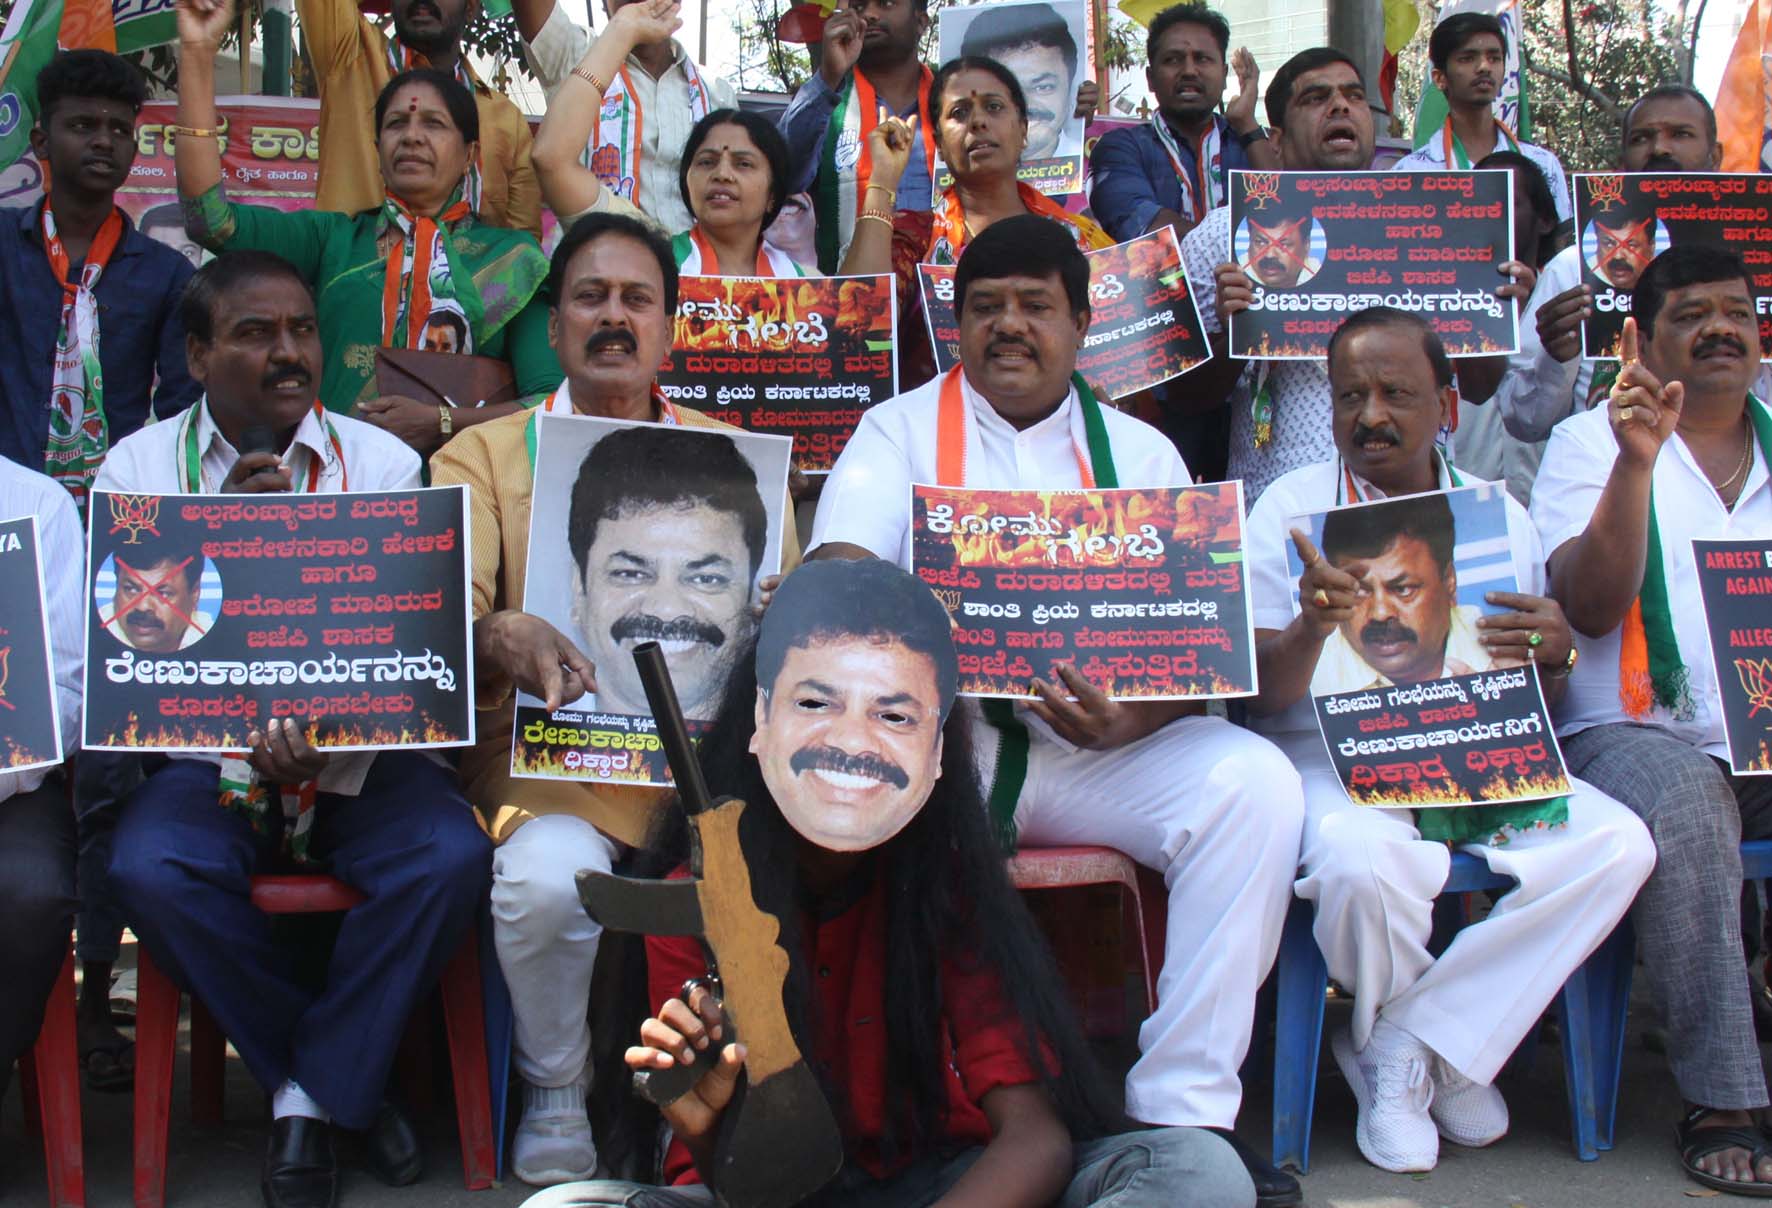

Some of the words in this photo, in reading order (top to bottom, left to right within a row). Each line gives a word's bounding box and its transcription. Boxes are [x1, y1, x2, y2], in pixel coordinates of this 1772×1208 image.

[1385, 223, 1443, 239] ಹಾಗೂ
[717, 383, 756, 404] ಪ್ರಿಯ
[765, 382, 871, 403] ಕರ್ನಾಟಕದಲ್ಲಿ
[1706, 551, 1761, 569] ARREST
[301, 562, 377, 583] ಹಾಗೂ
[1184, 563, 1242, 593] ಮತ್ತೆ
[329, 587, 443, 614] ಮಾಡಿರುವ
[963, 600, 1021, 618] ಶಾಂತಿ
[1032, 601, 1079, 625] ಪ್ರಿಯ
[1090, 598, 1218, 622] ಕರ್ನಾಟಕದಲ್ಲಿ
[322, 624, 395, 646] ಶಾಸಕ
[1005, 627, 1064, 648] ಹಾಗೂ
[105, 648, 456, 691] ರೇಣುಕಾಚಾರ್ಯನನ್ನು
[1325, 693, 1382, 714] ಕೋಮು
[1418, 701, 1478, 724] ಶಾಸಕ
[524, 720, 664, 751] ರೇಣುಕಾಚಾ
[1338, 713, 1543, 757] ರೇಣುಕಾಚಾರ್ಯನಿಗೆ
[564, 751, 628, 777] ಧಿಕ್ಕಾರ
